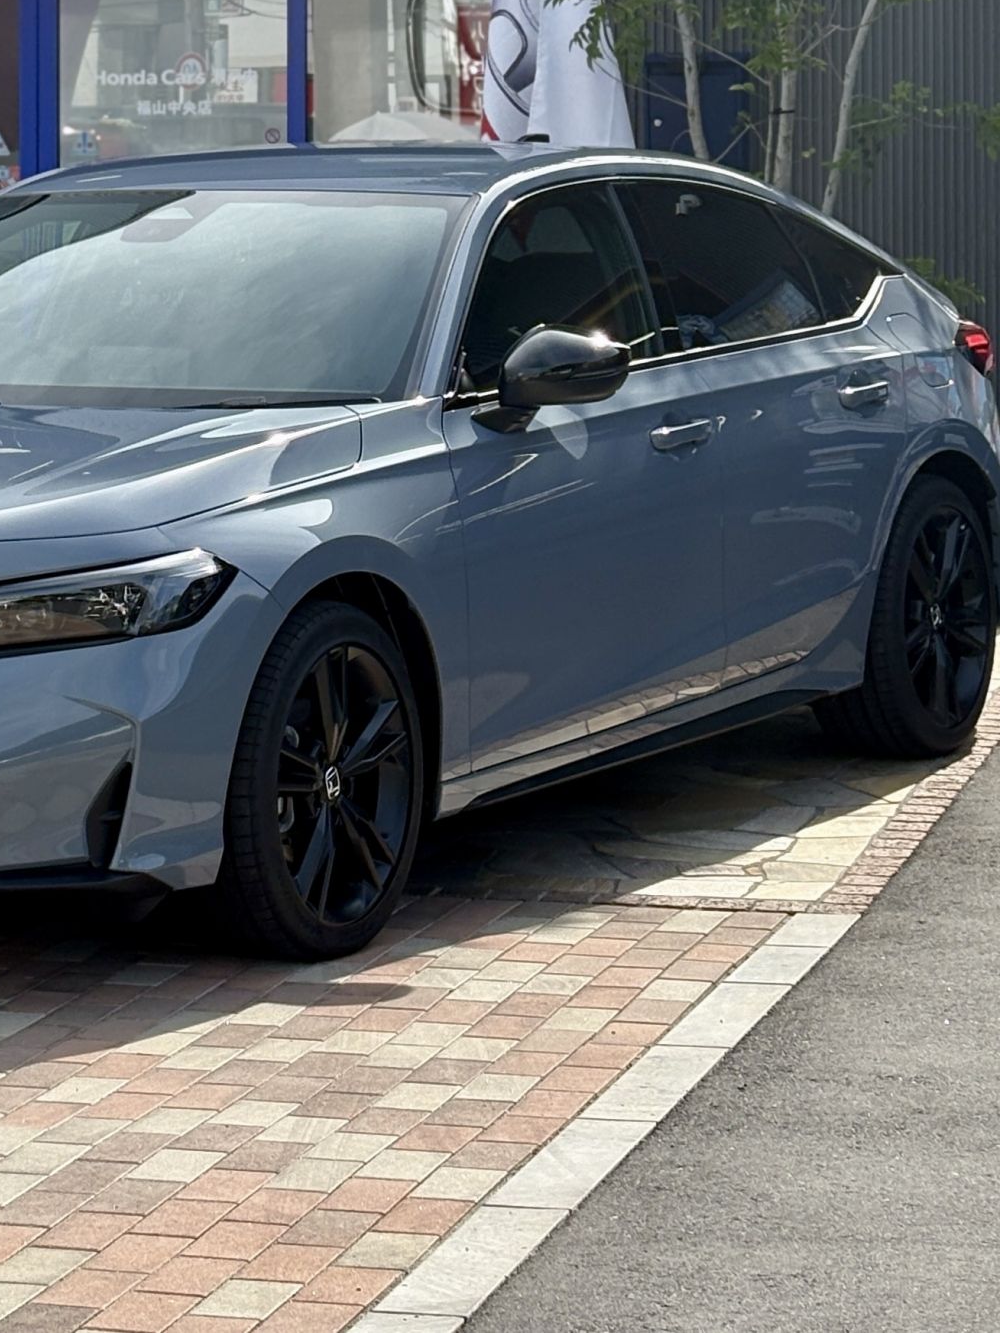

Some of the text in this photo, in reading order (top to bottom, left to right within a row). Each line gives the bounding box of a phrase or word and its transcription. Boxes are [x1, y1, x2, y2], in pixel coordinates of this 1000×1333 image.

[96, 69, 157, 86] Honda
[161, 69, 206, 86] Cars
[137, 99, 212, 116] 福山中央店
